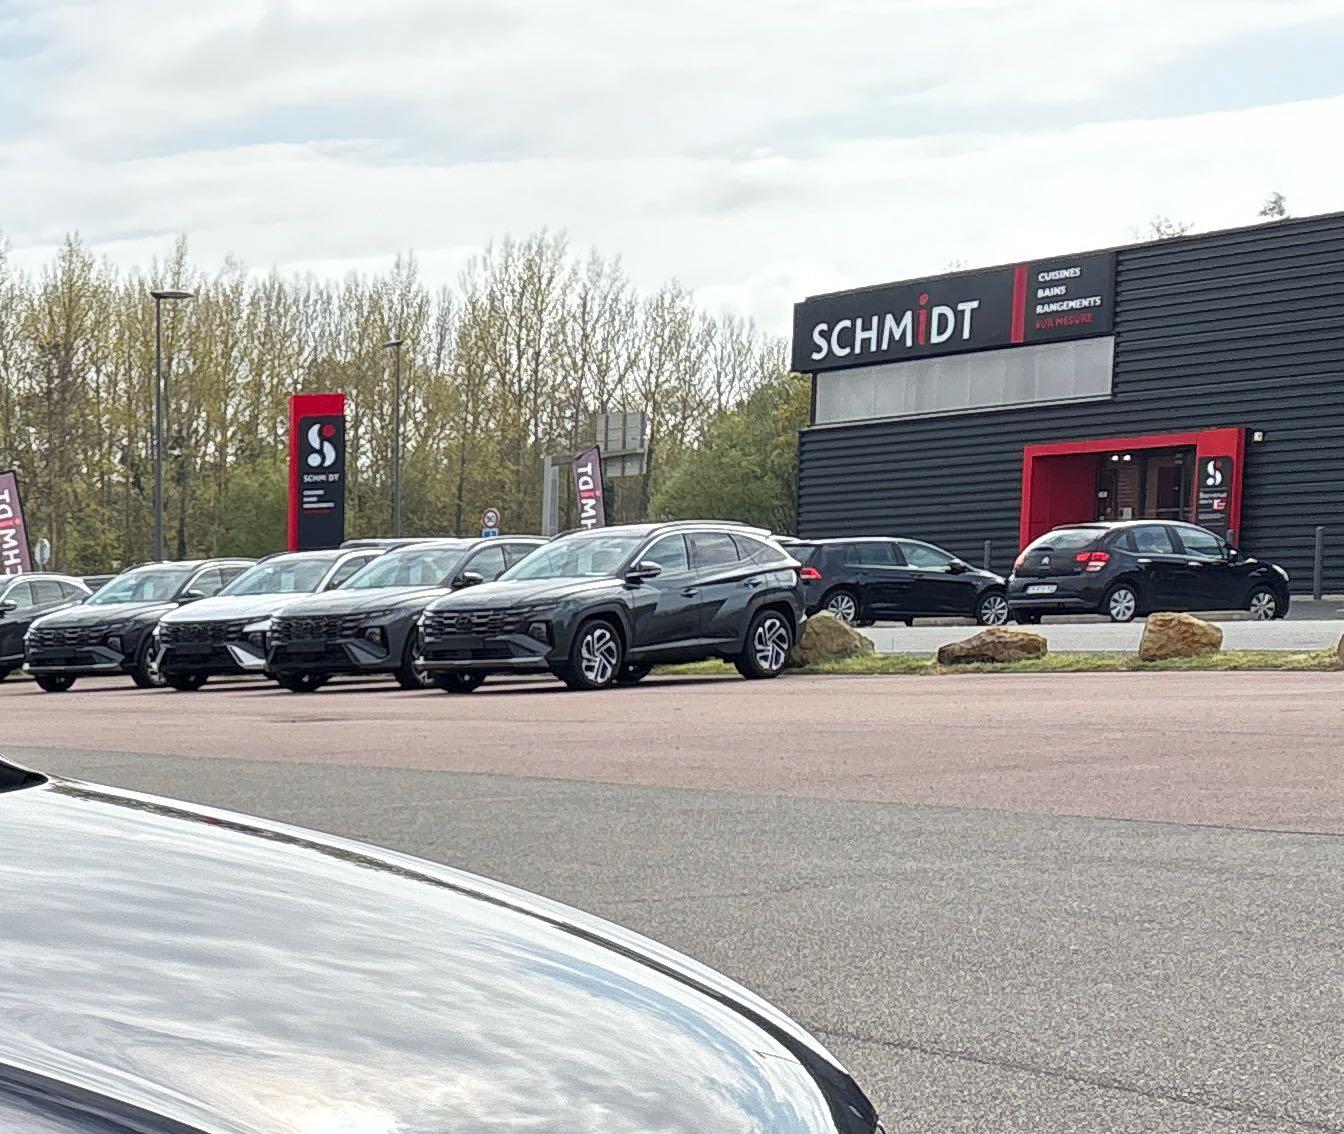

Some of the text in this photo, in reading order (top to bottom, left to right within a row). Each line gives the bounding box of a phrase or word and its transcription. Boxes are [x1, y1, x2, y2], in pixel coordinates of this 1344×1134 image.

[1037, 267, 1081, 282] CUISINES
[1037, 285, 1066, 299] BAINS
[1035, 296, 1102, 315] RANGEMENTS
